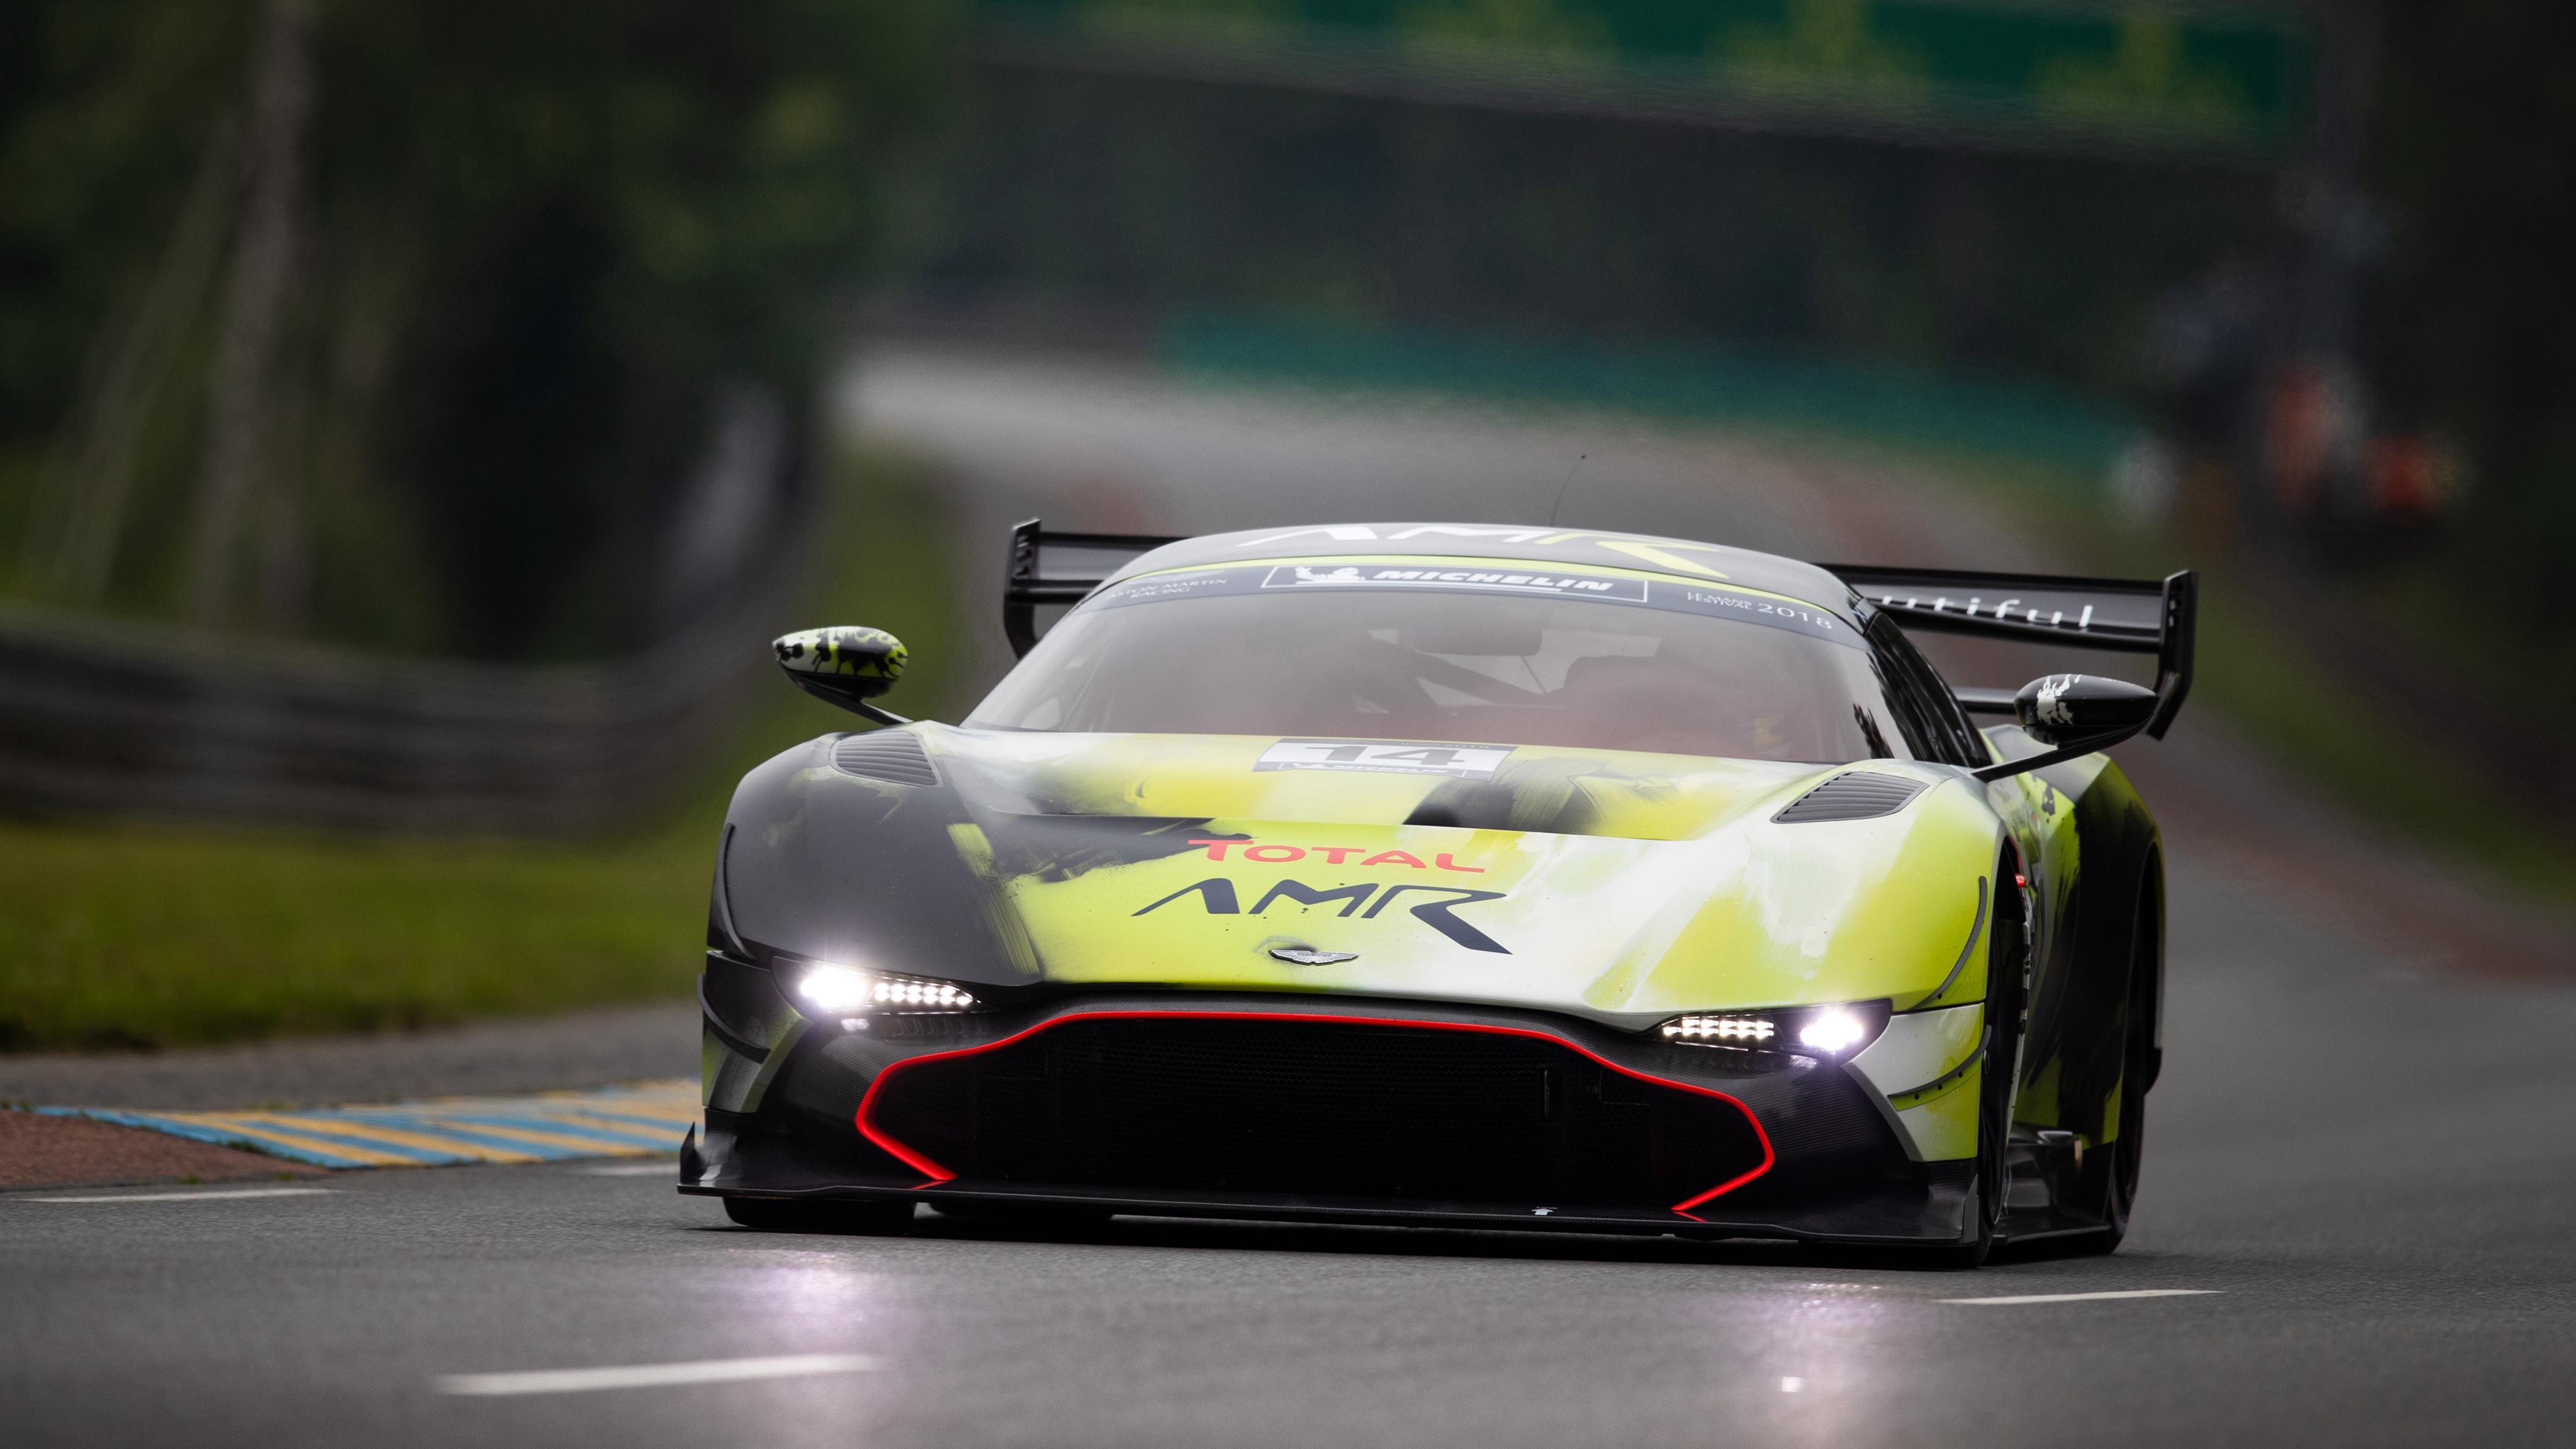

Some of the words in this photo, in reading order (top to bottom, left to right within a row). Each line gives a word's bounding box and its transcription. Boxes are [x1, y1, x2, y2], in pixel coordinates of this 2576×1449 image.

[1235, 526, 1731, 579] AMR
[1130, 587, 1191, 597] RACING
[1163, 579, 1227, 589] MARTIN
[1374, 570, 1614, 591] MICHELIN
[1757, 603, 1832, 630] 2018
[1306, 745, 1465, 766] 14
[1187, 839, 1485, 874] TOTAL
[1130, 878, 1513, 955] AMR
